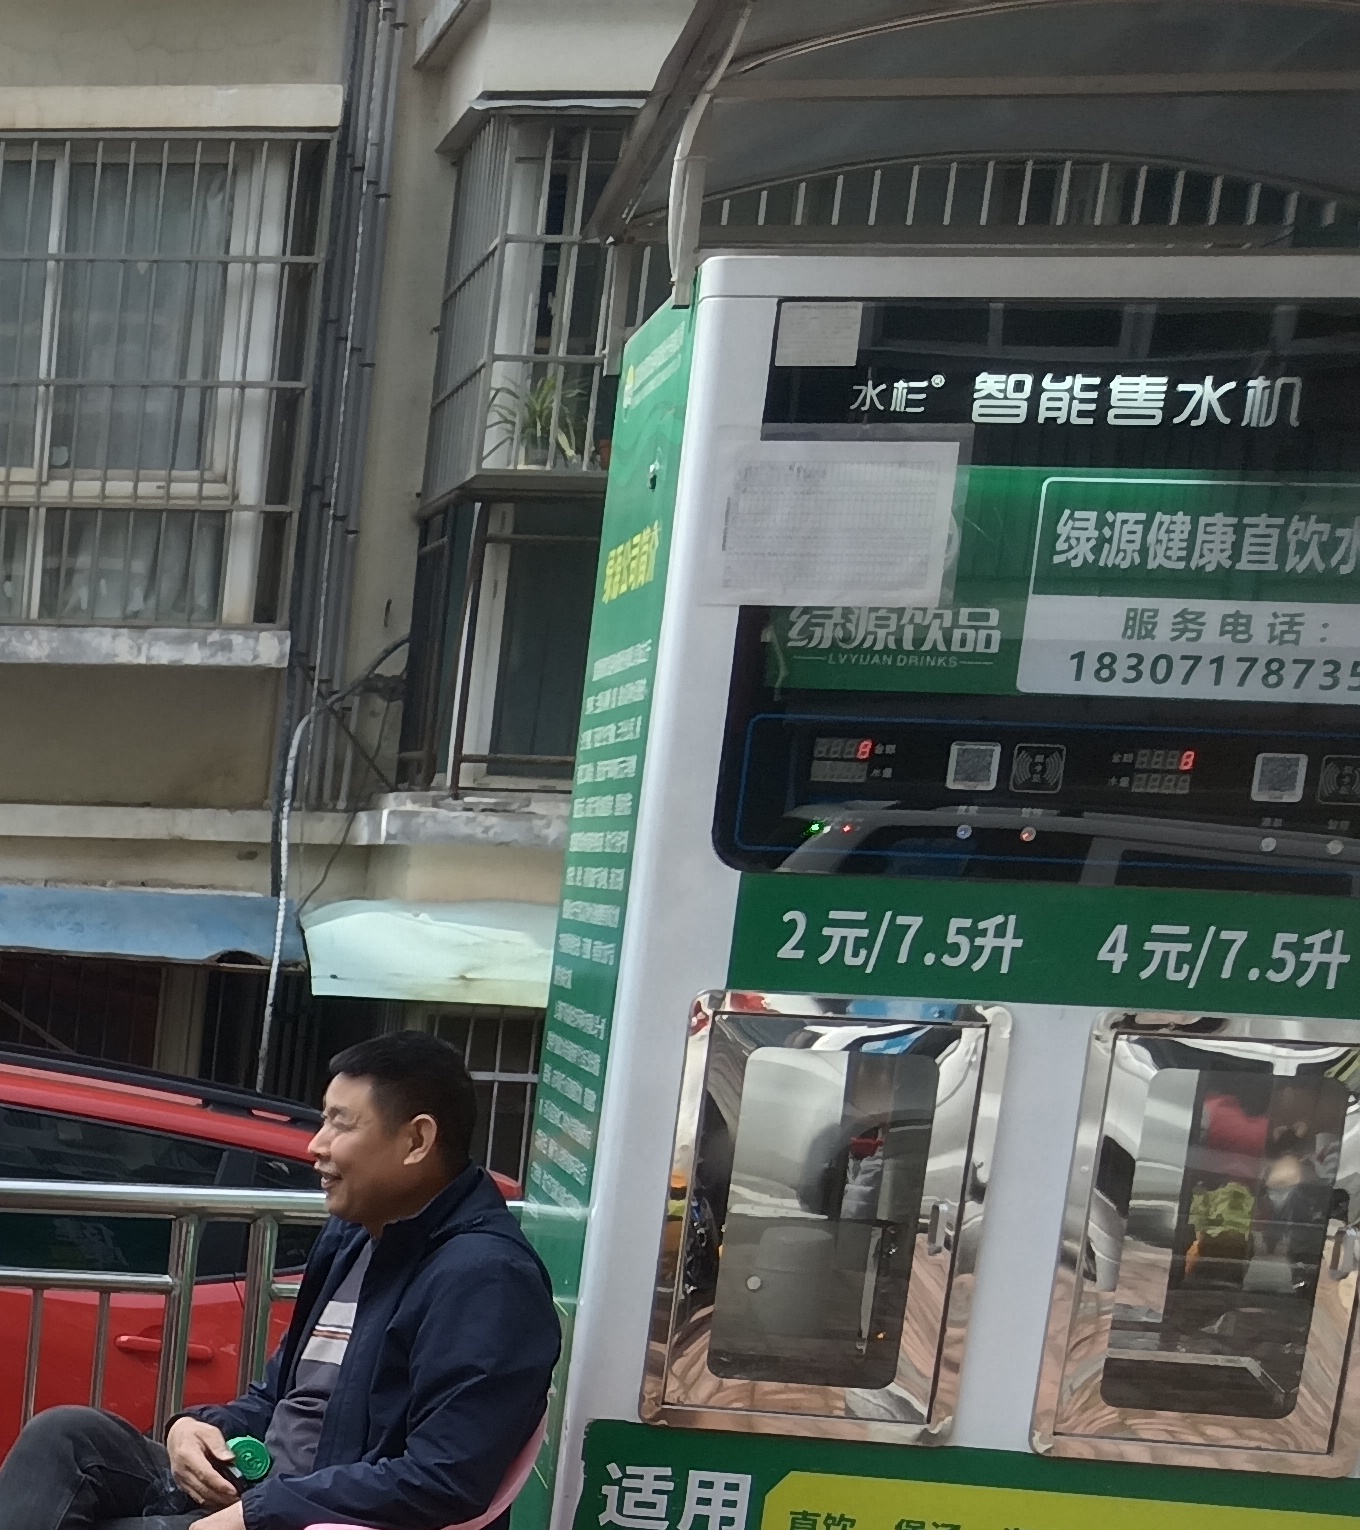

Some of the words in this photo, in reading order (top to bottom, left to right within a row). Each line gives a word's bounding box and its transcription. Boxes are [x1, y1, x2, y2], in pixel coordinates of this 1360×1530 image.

[972, 372, 1300, 427] 智能售水机
[787, 606, 1002, 653] 绿源饮品
[896, 654, 958, 668] DRINKS
